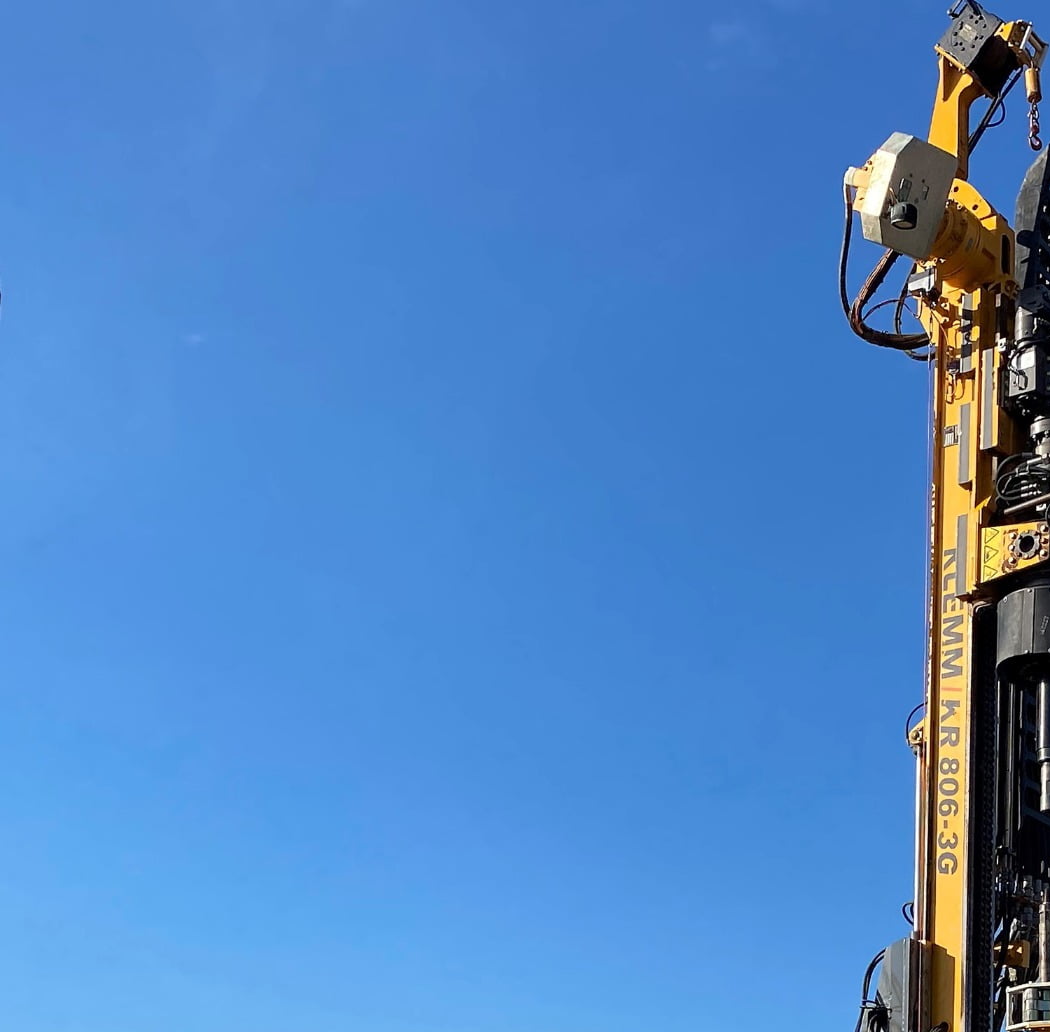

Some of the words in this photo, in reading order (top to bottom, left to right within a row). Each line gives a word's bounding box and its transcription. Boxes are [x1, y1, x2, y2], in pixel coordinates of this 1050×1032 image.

[942, 548, 963, 679] KLEMM
[940, 700, 960, 747] KR
[938, 757, 959, 875] 806-3G
